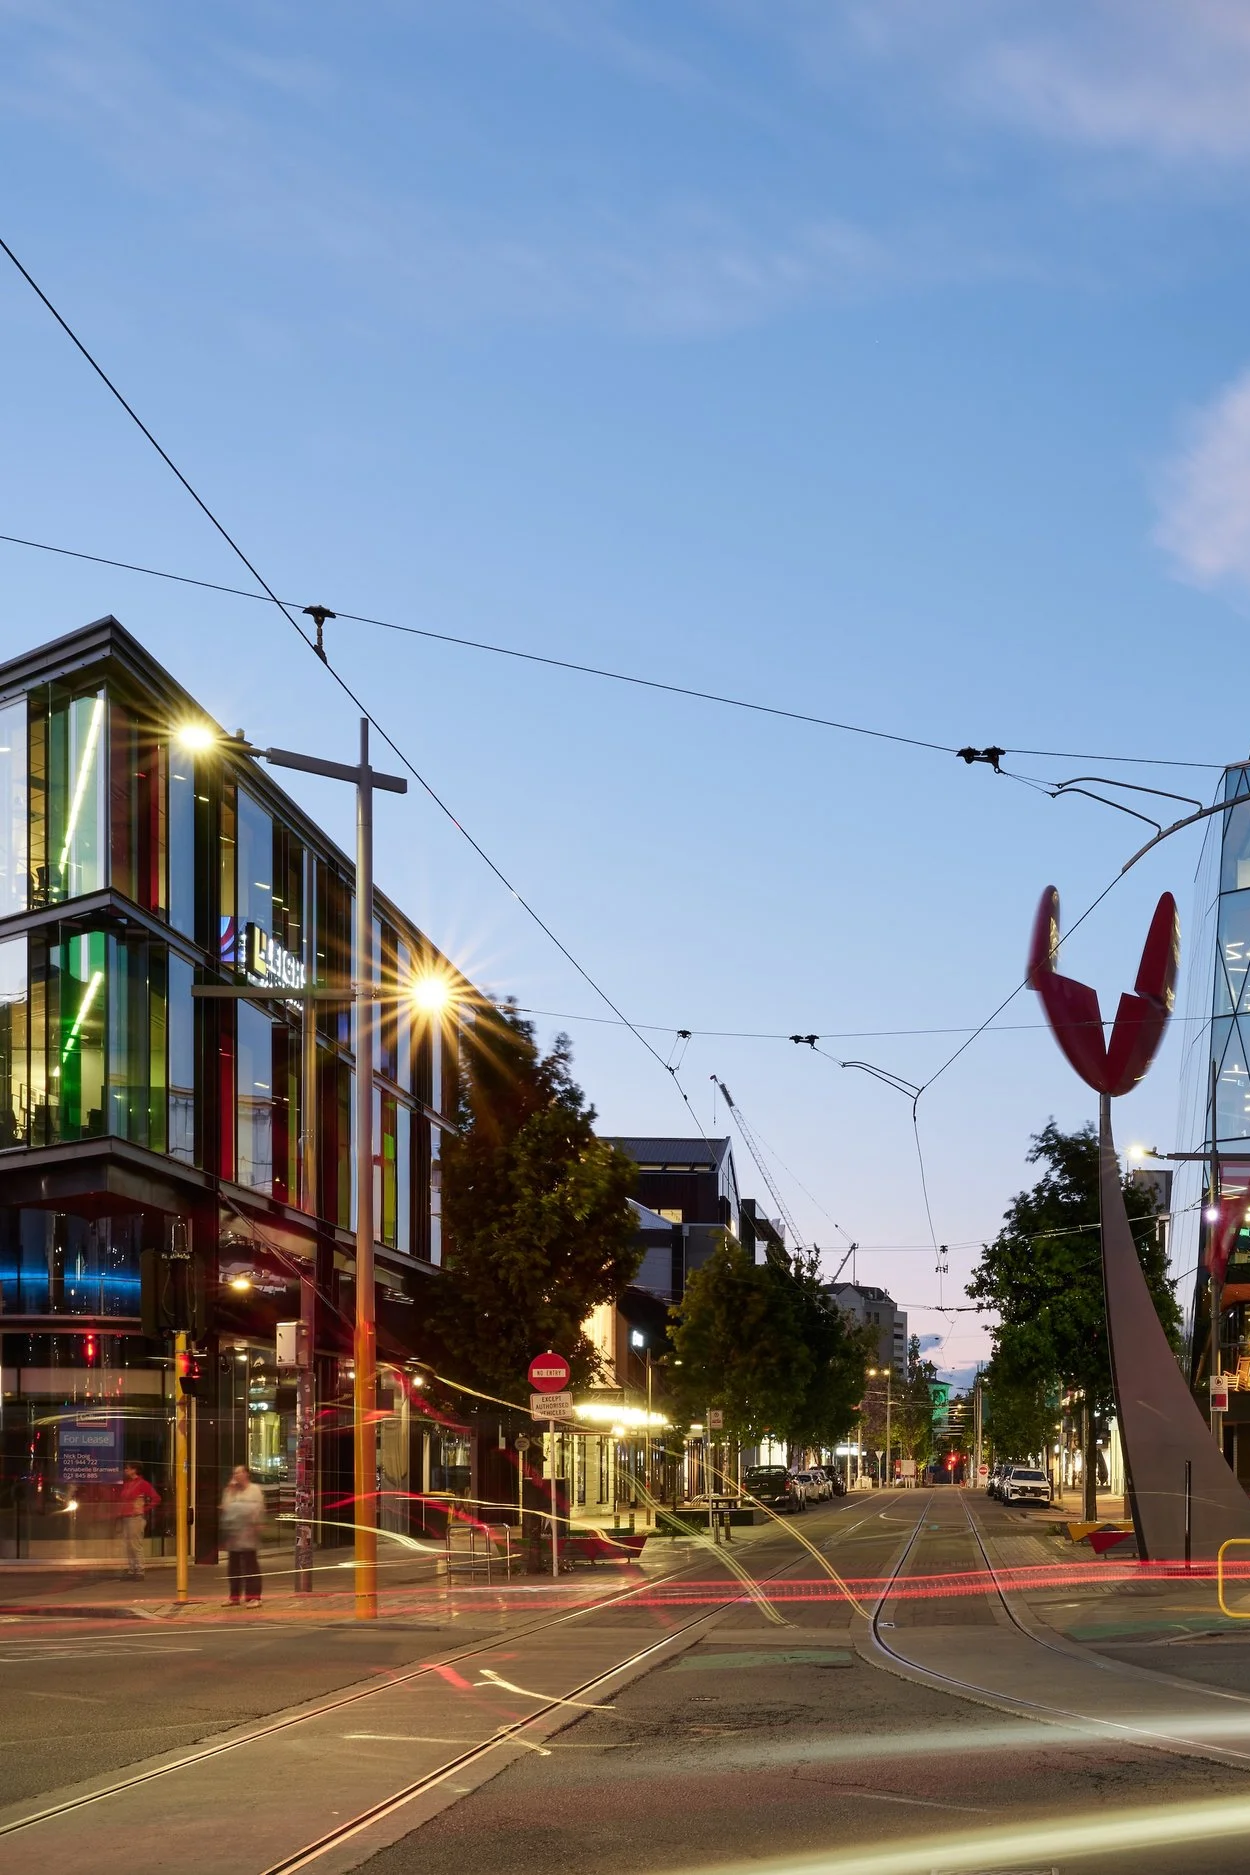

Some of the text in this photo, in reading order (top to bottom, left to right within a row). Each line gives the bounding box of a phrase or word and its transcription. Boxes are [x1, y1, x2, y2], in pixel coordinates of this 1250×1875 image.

[541, 1395, 562, 1403] EXCEPT
[535, 1402, 570, 1410] AUTHORISED
[539, 1409, 566, 1417] VEHICLES
[64, 1435, 109, 1444] For Lease
